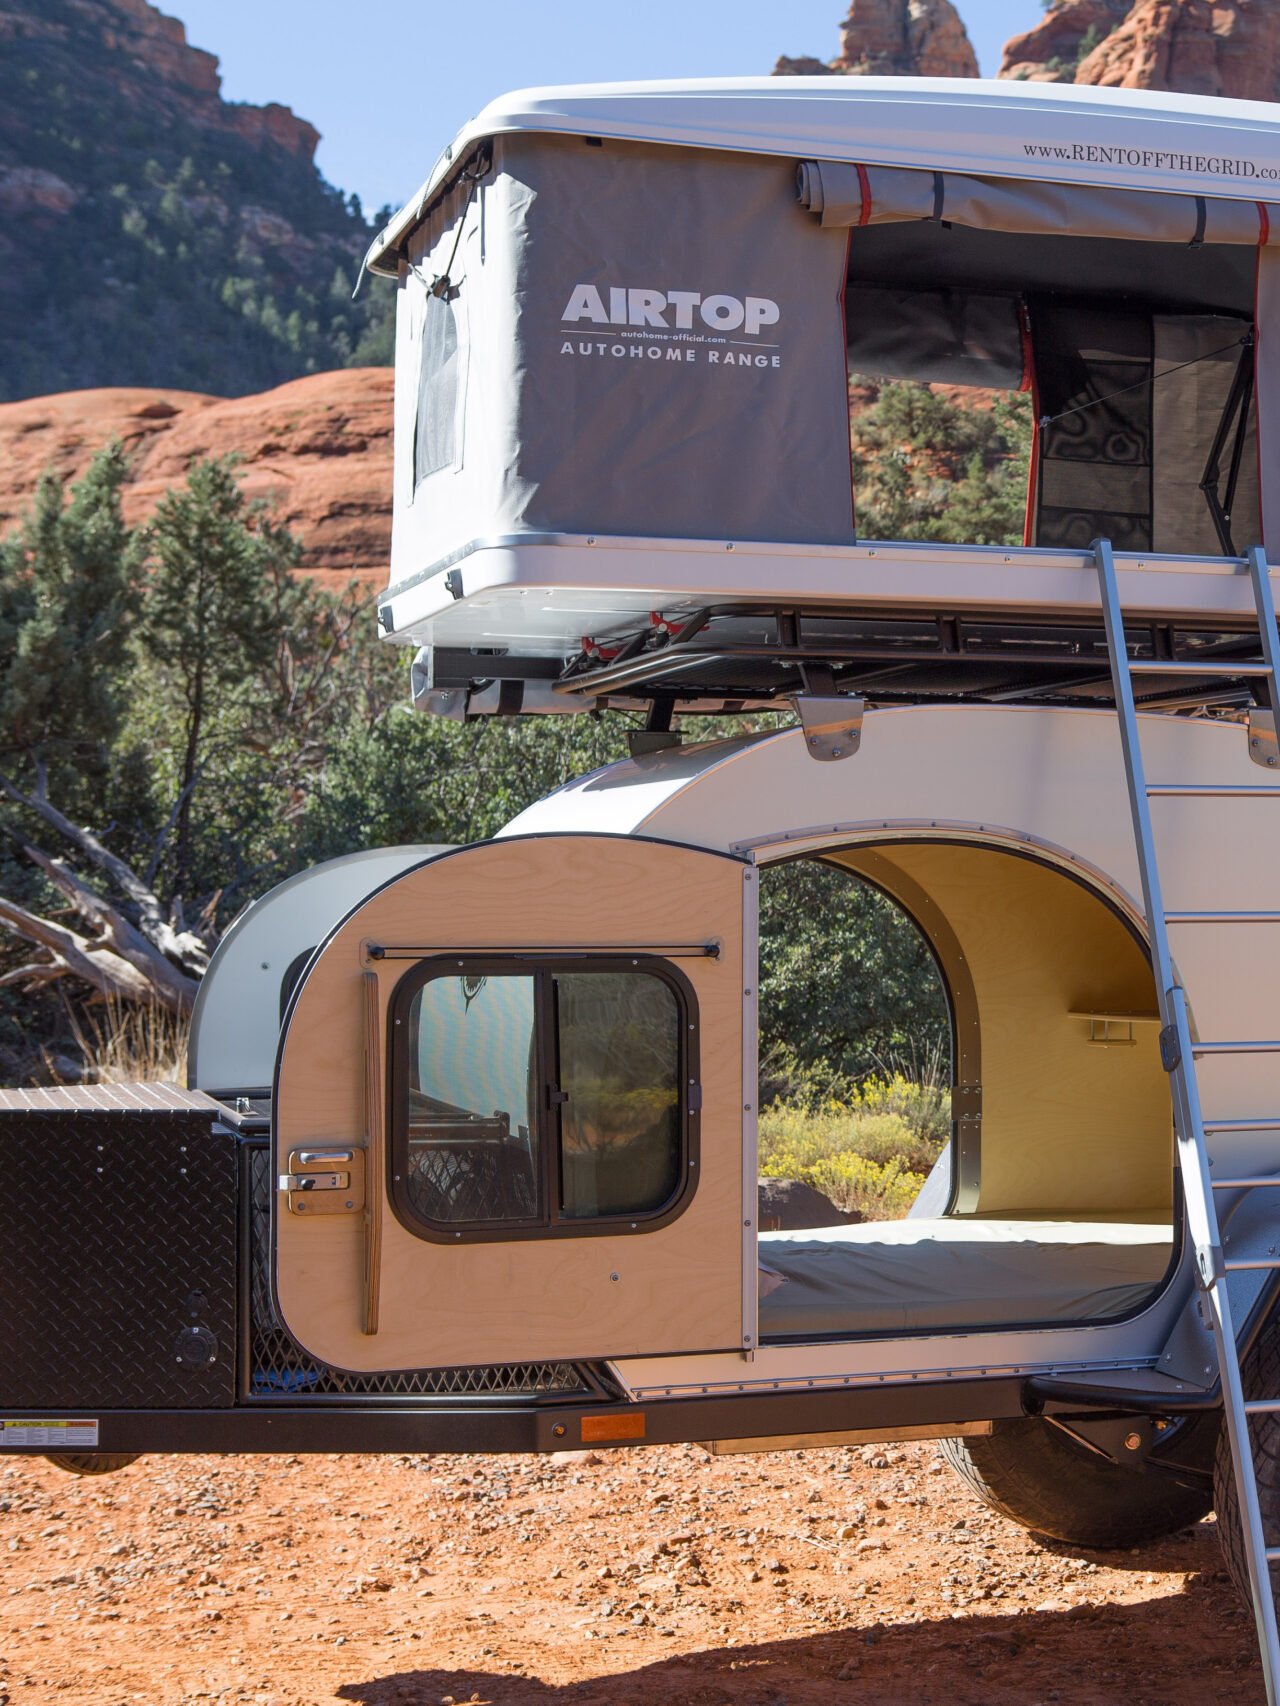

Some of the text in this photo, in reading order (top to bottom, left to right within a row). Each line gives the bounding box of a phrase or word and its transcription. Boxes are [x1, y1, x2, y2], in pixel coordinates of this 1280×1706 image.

[561, 283, 780, 335] AIRTOP
[620, 331, 727, 344] autohome-official.com
[560, 341, 781, 368] AUTOHOME RANGE
